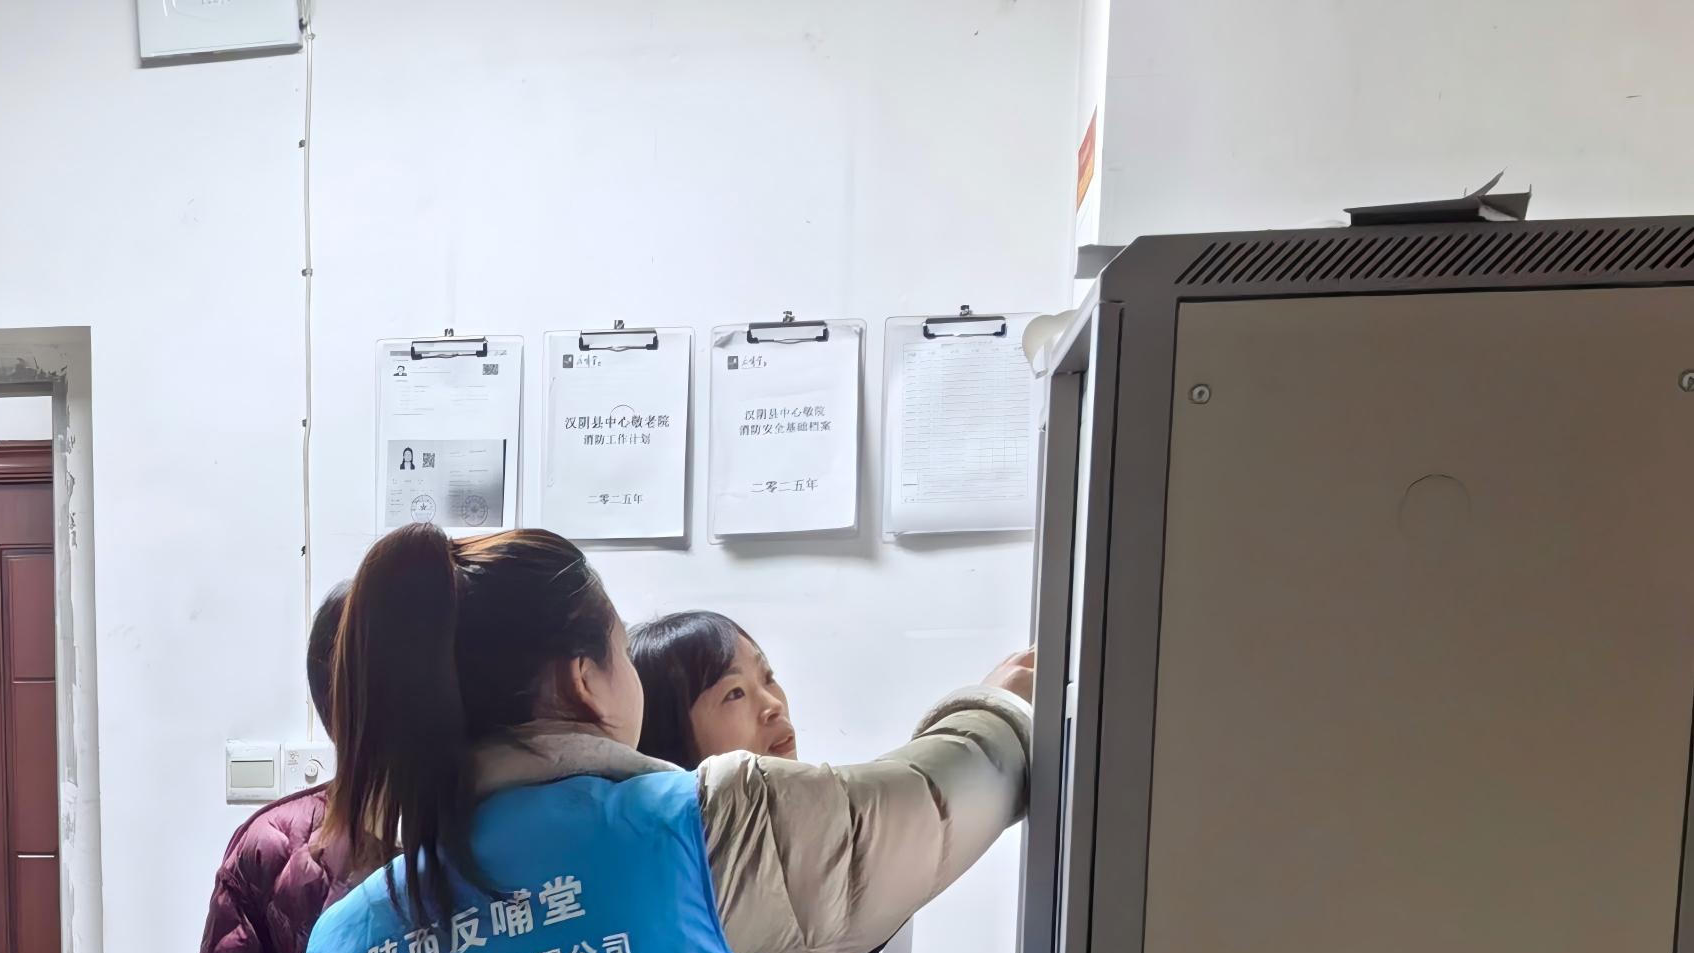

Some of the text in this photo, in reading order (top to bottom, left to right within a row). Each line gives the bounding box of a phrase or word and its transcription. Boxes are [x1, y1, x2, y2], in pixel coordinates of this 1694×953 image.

[565, 415, 670, 430] 汉阴县中心敬老院
[739, 420, 832, 436] 消防安全基础档案
[583, 433, 651, 446] 消防工作计划
[750, 477, 819, 493] 二零二五年
[586, 493, 643, 505] 二零二五年
